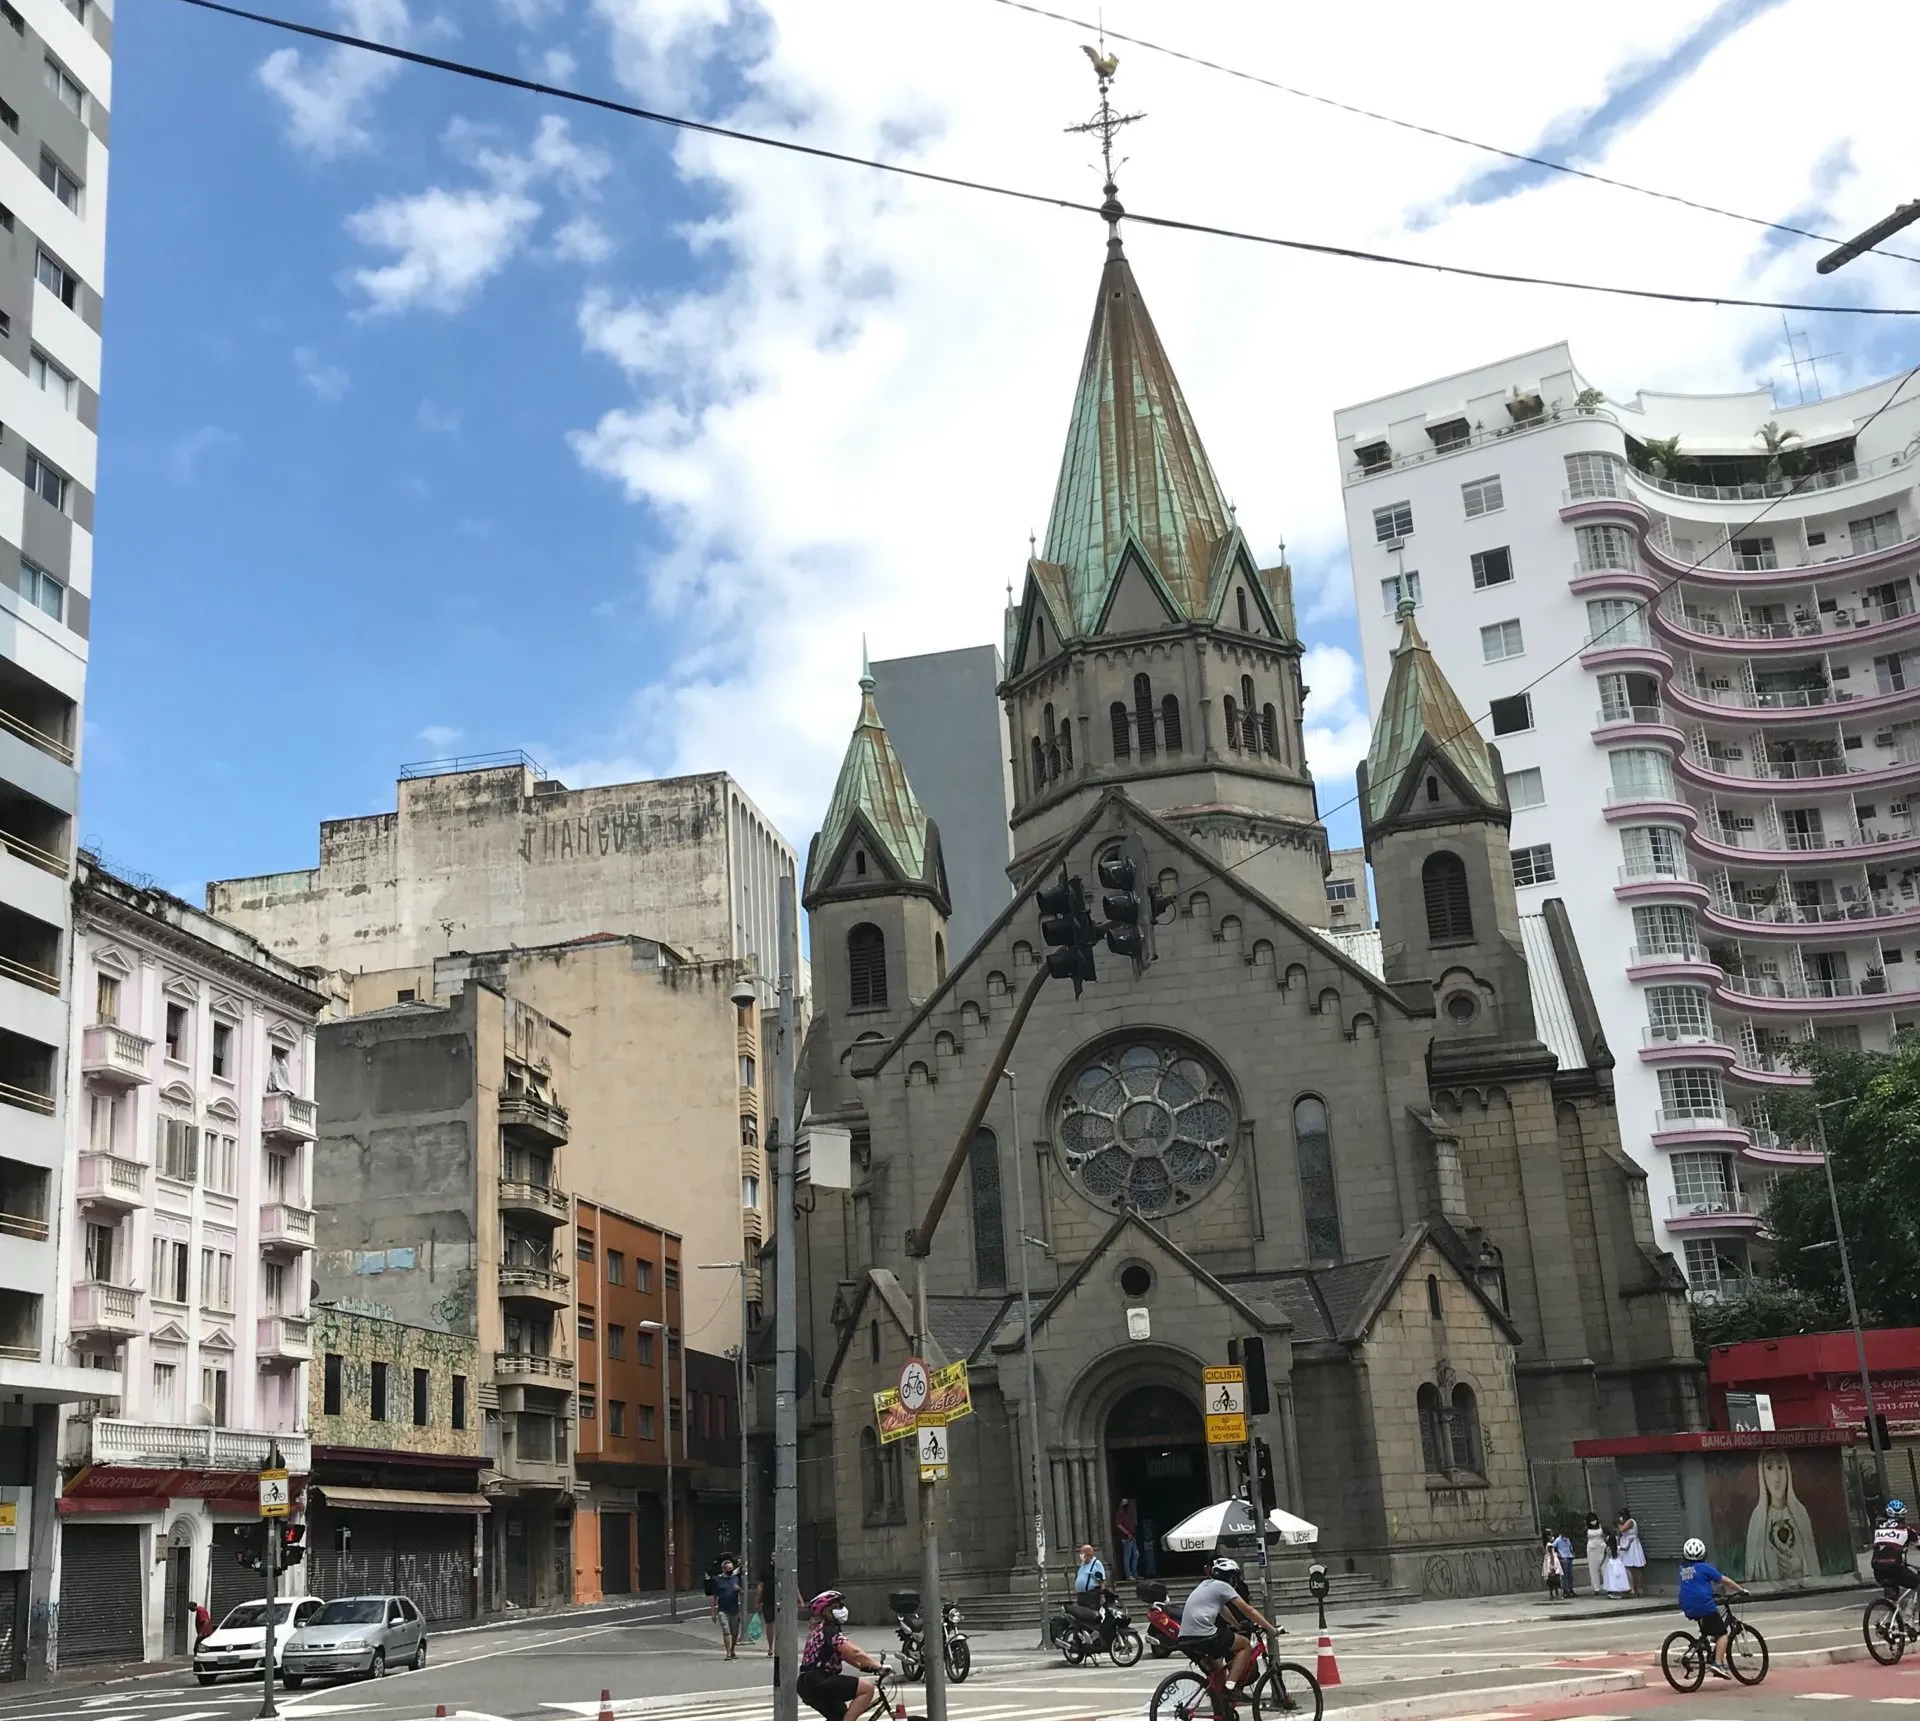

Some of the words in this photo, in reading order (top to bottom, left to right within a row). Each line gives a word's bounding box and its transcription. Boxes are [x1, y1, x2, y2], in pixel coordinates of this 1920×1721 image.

[1205, 1370, 1242, 1380] CICLISTA
[1701, 1435, 1732, 1447] BANCA
[1734, 1434, 1763, 1446] NOSSA
[1765, 1432, 1806, 1445] SENHORA
[1807, 1431, 1819, 1443] DE
[1228, 1523, 1268, 1532] Ub
[1292, 1531, 1311, 1542] Uber
[1180, 1538, 1205, 1550] Uber
[1311, 1581, 1324, 1589] Uber
